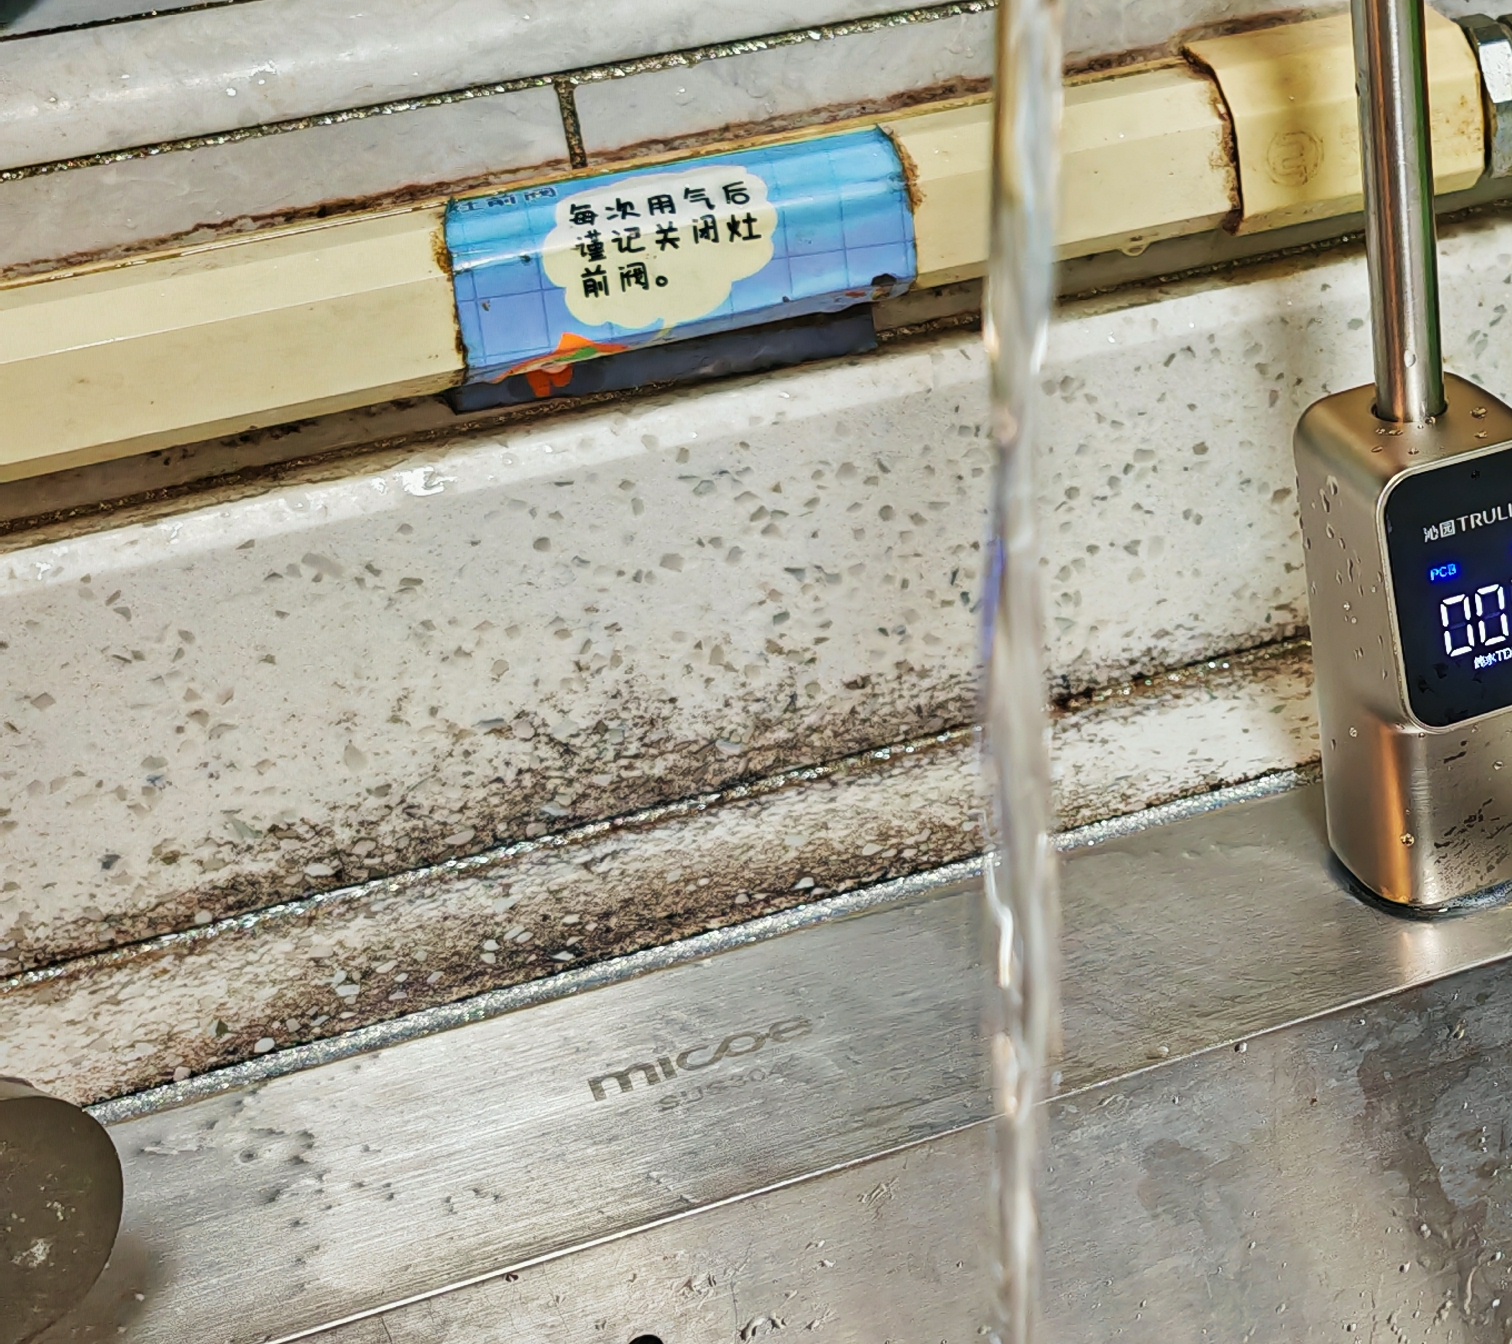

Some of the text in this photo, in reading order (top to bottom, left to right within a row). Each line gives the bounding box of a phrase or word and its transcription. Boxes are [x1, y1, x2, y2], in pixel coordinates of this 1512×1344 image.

[568, 180, 754, 227] 每次用气后
[575, 212, 762, 262] 谨记关闭灶
[580, 265, 670, 299] 前阀。
[1423, 519, 1456, 543] 沁园
[587, 1016, 813, 1102] micoe
